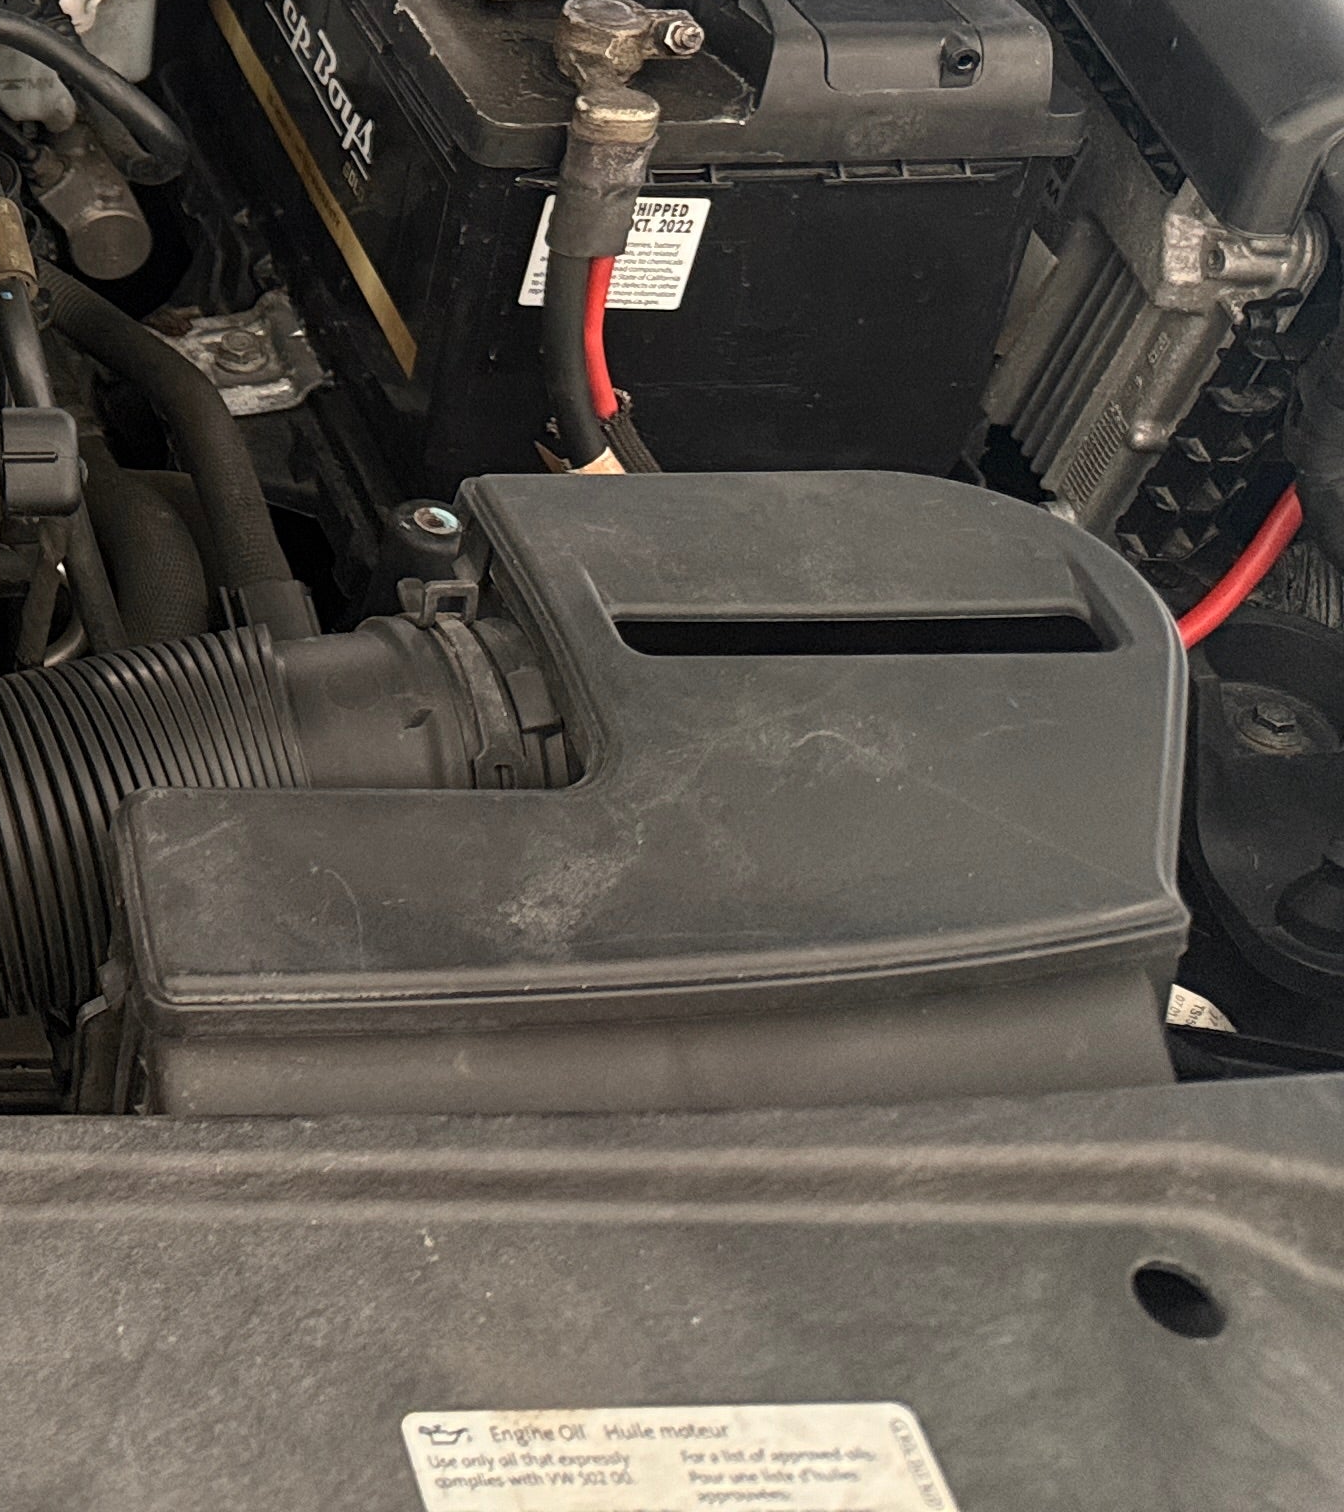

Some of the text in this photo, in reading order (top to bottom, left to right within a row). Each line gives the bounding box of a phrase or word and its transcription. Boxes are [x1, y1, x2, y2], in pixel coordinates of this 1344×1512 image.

[313, 28, 374, 166] Boys
[633, 203, 689, 217] HIPPED
[633, 219, 694, 234] CT. 2022
[489, 1424, 586, 1447] Engine Oil
[604, 1423, 730, 1439] Huile moteur
[427, 1452, 631, 1471] Use only oil that expressly
[434, 1473, 505, 1491] complies
[508, 1472, 544, 1486] with
[548, 1471, 574, 1486] VW
